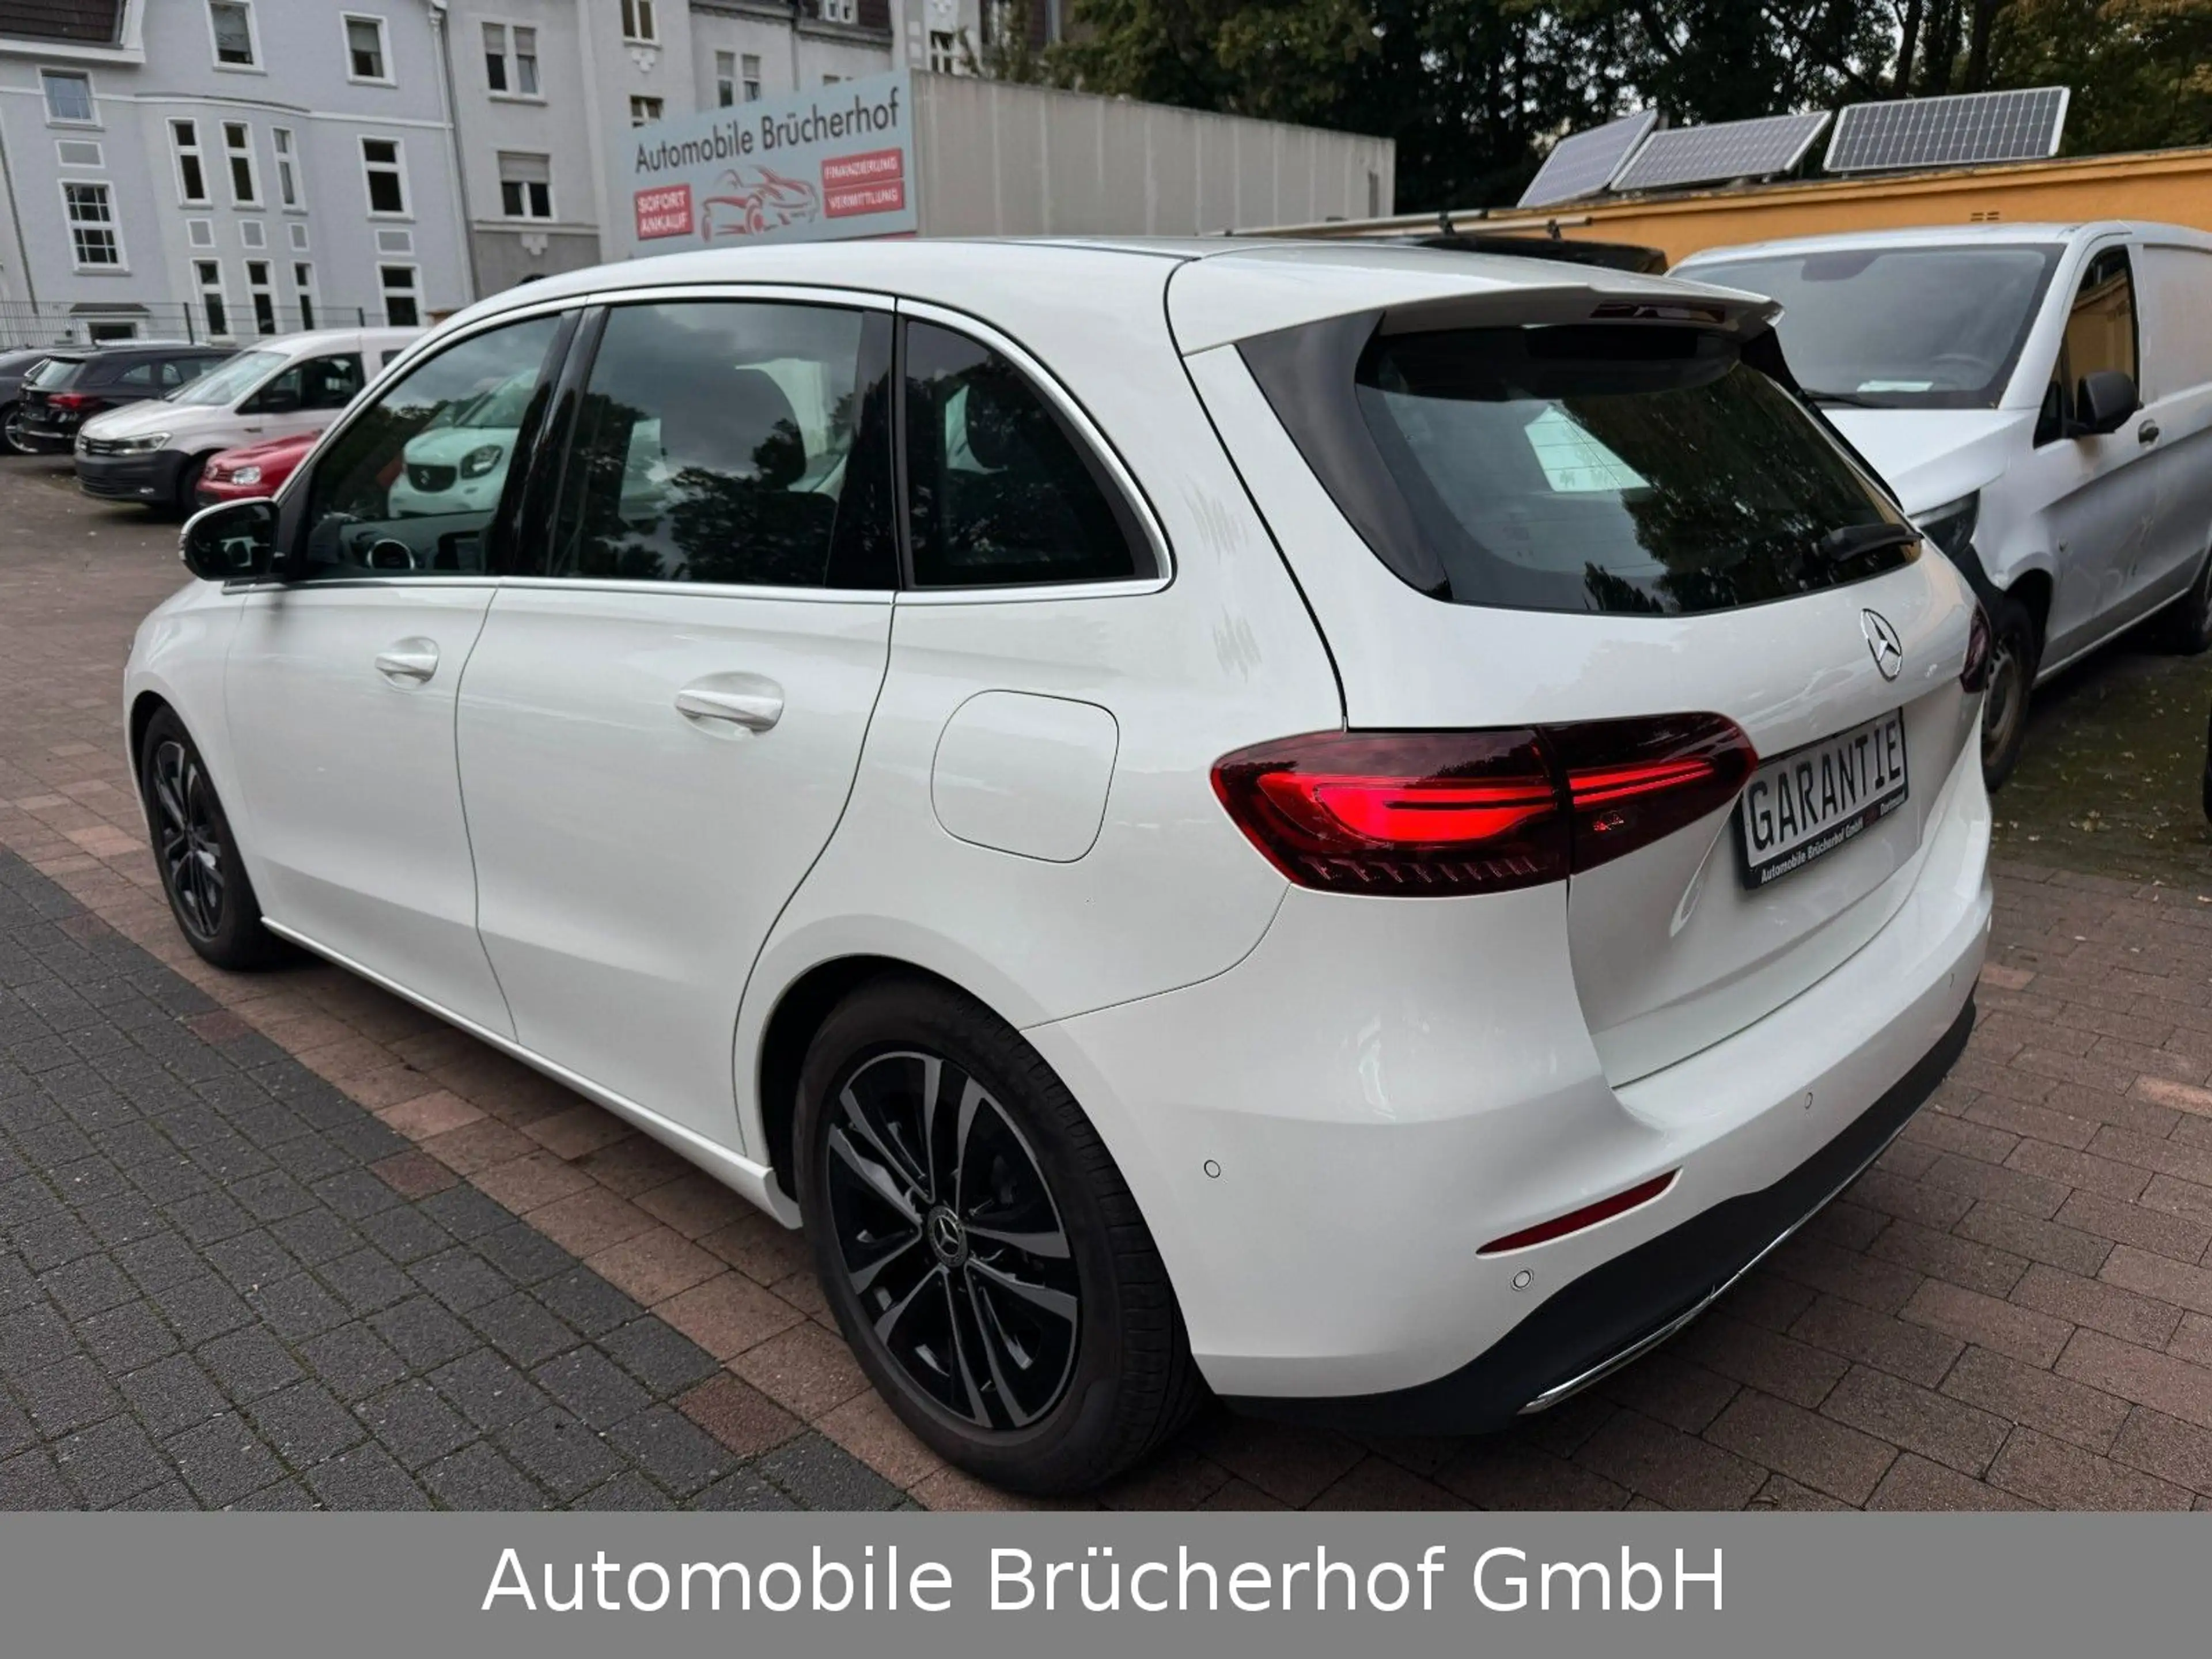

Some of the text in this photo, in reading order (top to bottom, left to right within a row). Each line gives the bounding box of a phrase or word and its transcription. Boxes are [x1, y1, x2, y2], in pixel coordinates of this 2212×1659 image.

[635, 86, 900, 173] Automobile Brücherhof
[638, 190, 686, 213] SOFORT
[641, 212, 687, 235] ANKAUF
[1748, 720, 1901, 851] GARANTIE
[1761, 850, 1806, 884] Automobile
[1807, 828, 1844, 859] Brücherhof
